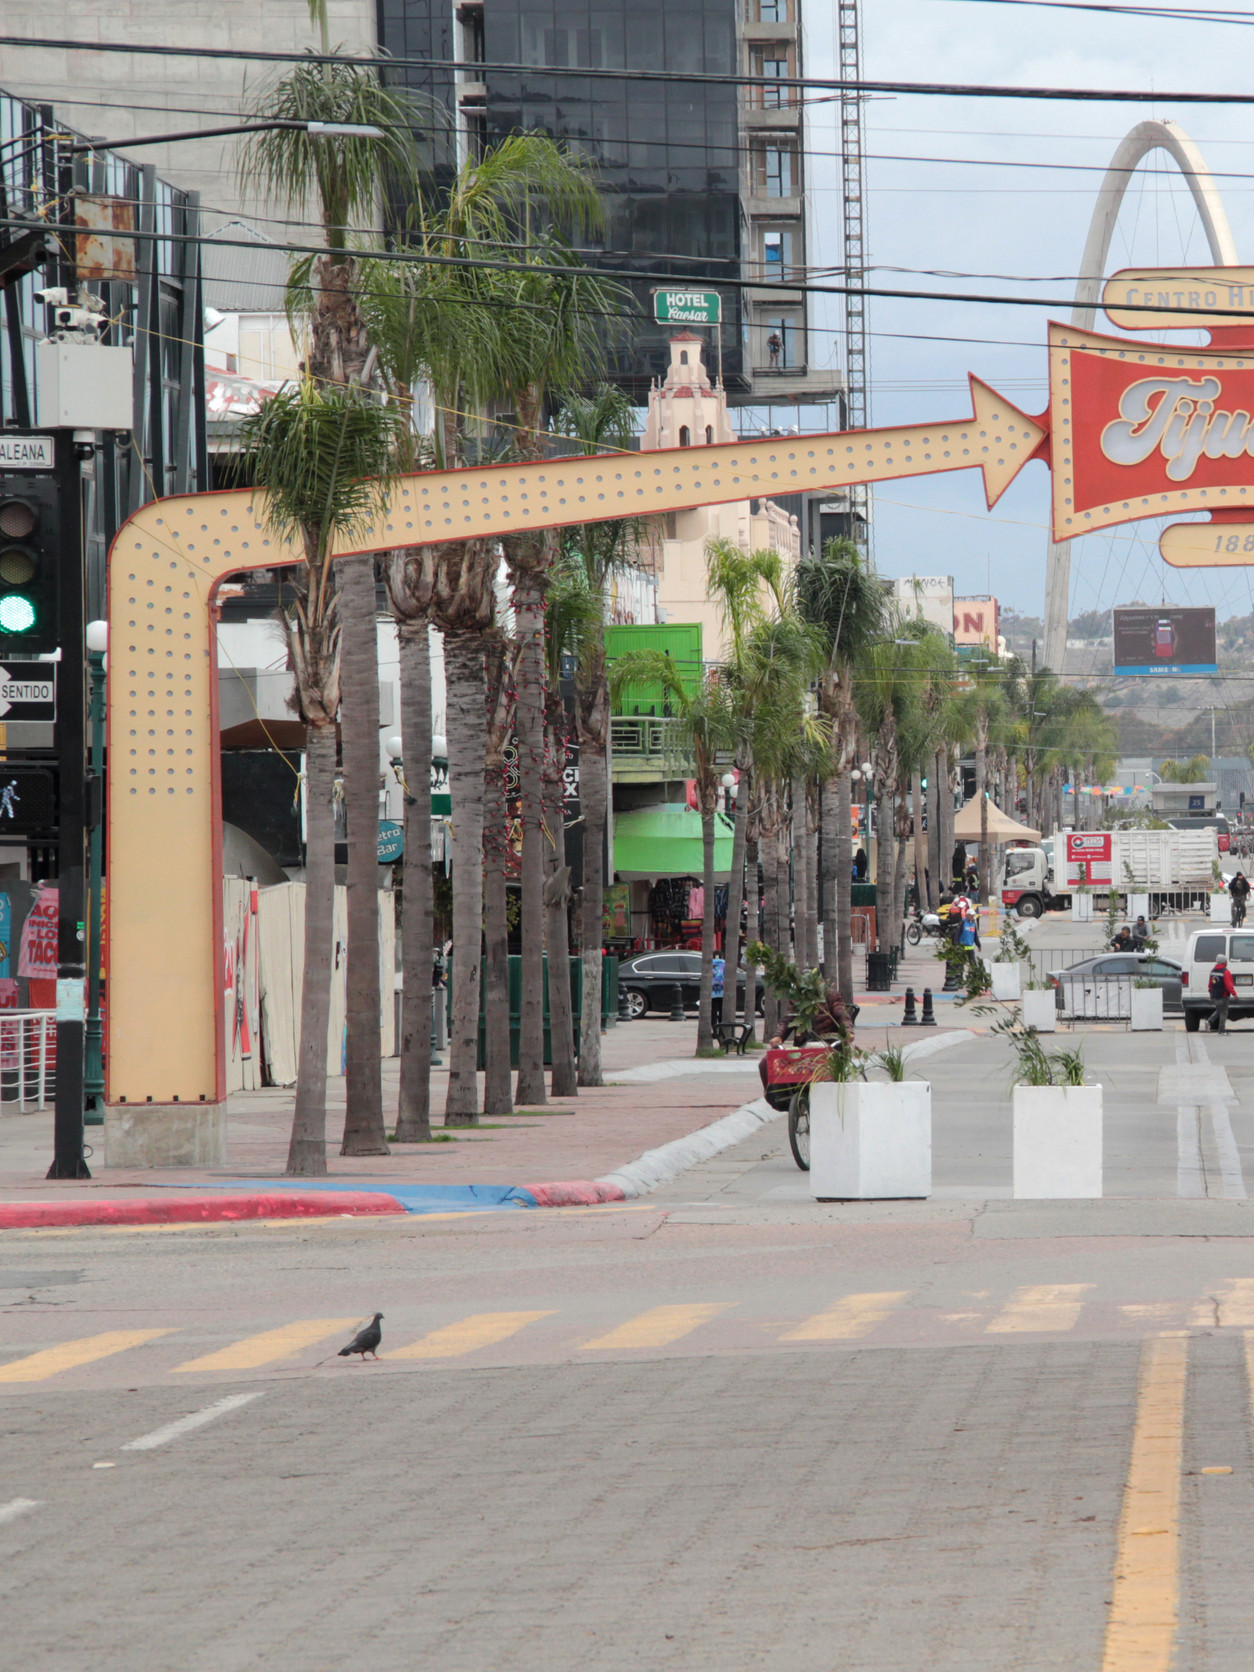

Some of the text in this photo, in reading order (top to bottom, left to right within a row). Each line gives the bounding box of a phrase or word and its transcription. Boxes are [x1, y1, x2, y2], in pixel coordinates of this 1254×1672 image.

[666, 293, 709, 307] HOTEL
[1126, 288, 1217, 308] CENTRO
[1, 685, 49, 699] SENTIDO
[377, 843, 398, 856] Bar
